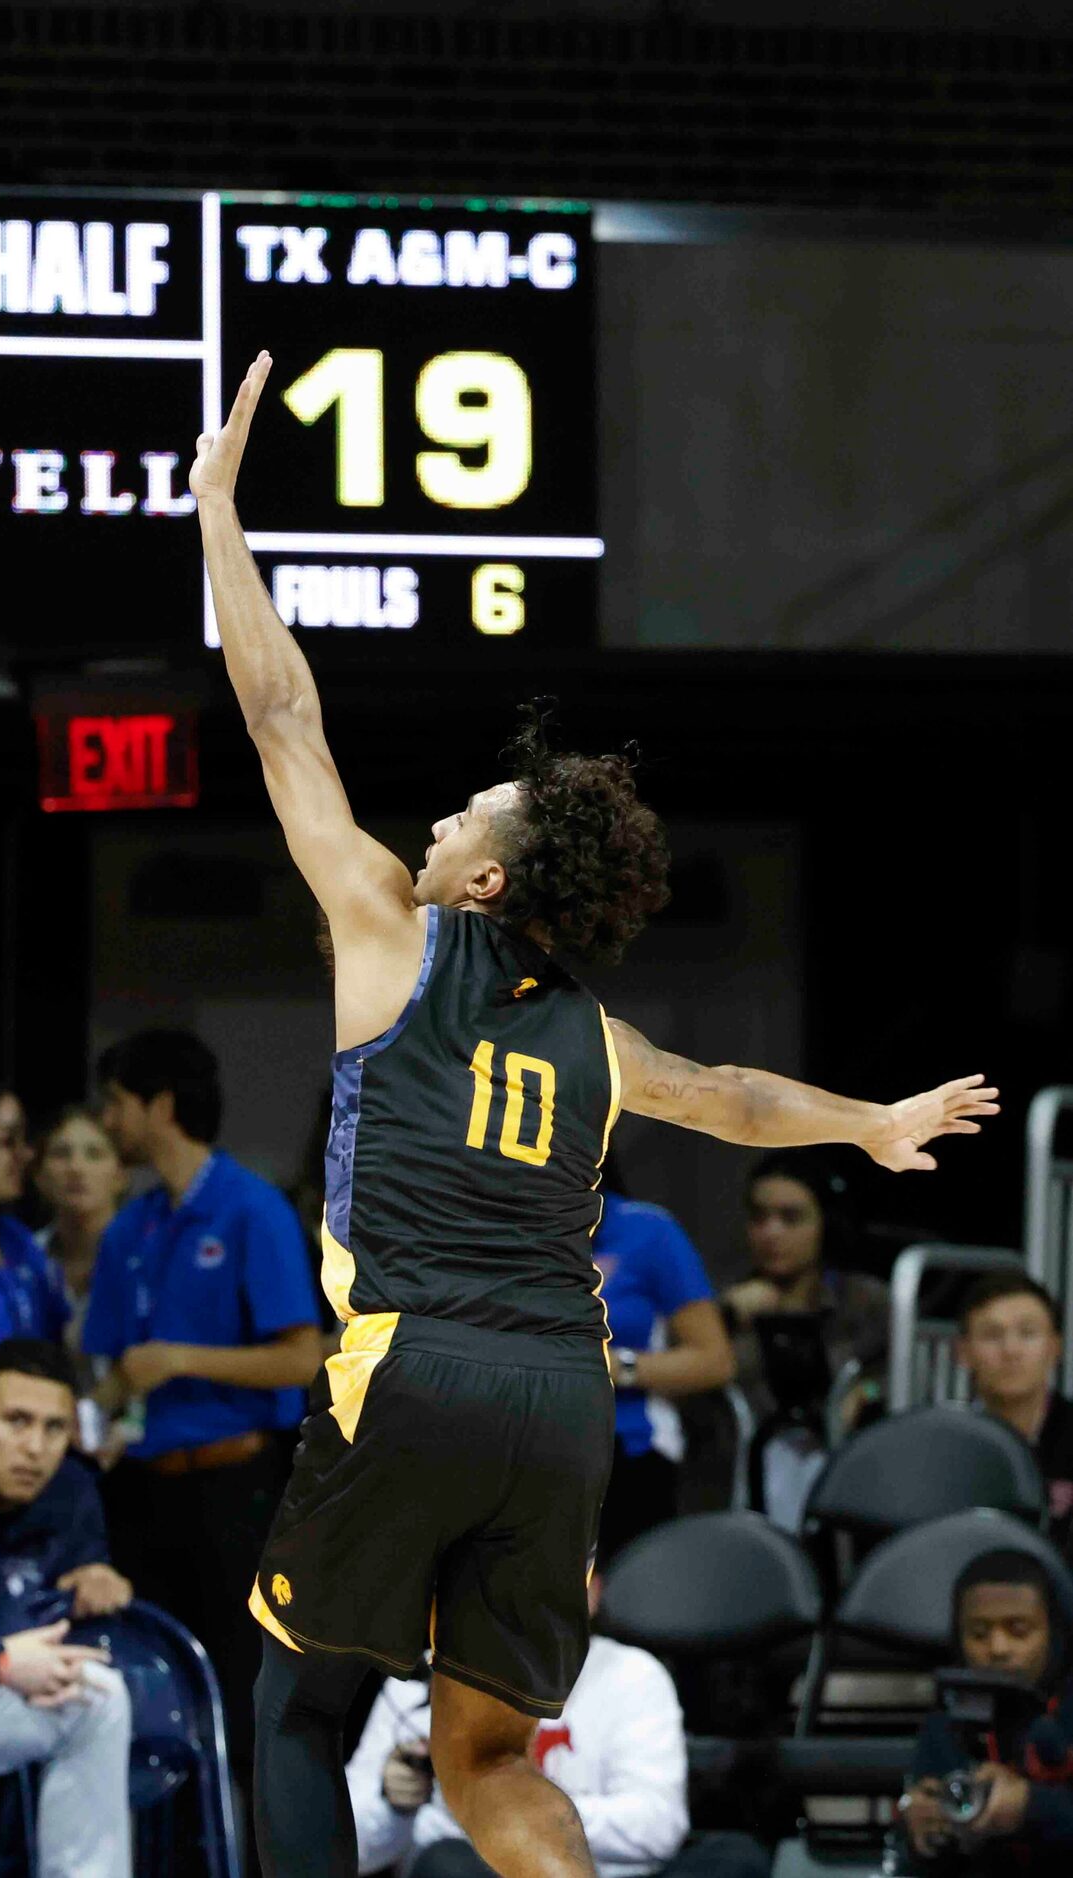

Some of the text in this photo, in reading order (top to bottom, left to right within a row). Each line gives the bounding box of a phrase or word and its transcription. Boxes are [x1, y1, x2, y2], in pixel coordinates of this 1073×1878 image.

[236, 224, 577, 290] TX A&M-C
[282, 346, 534, 511] 19
[272, 563, 525, 636] FOULS 6
[68, 715, 174, 796] EXIT
[465, 1040, 556, 1167] 10
